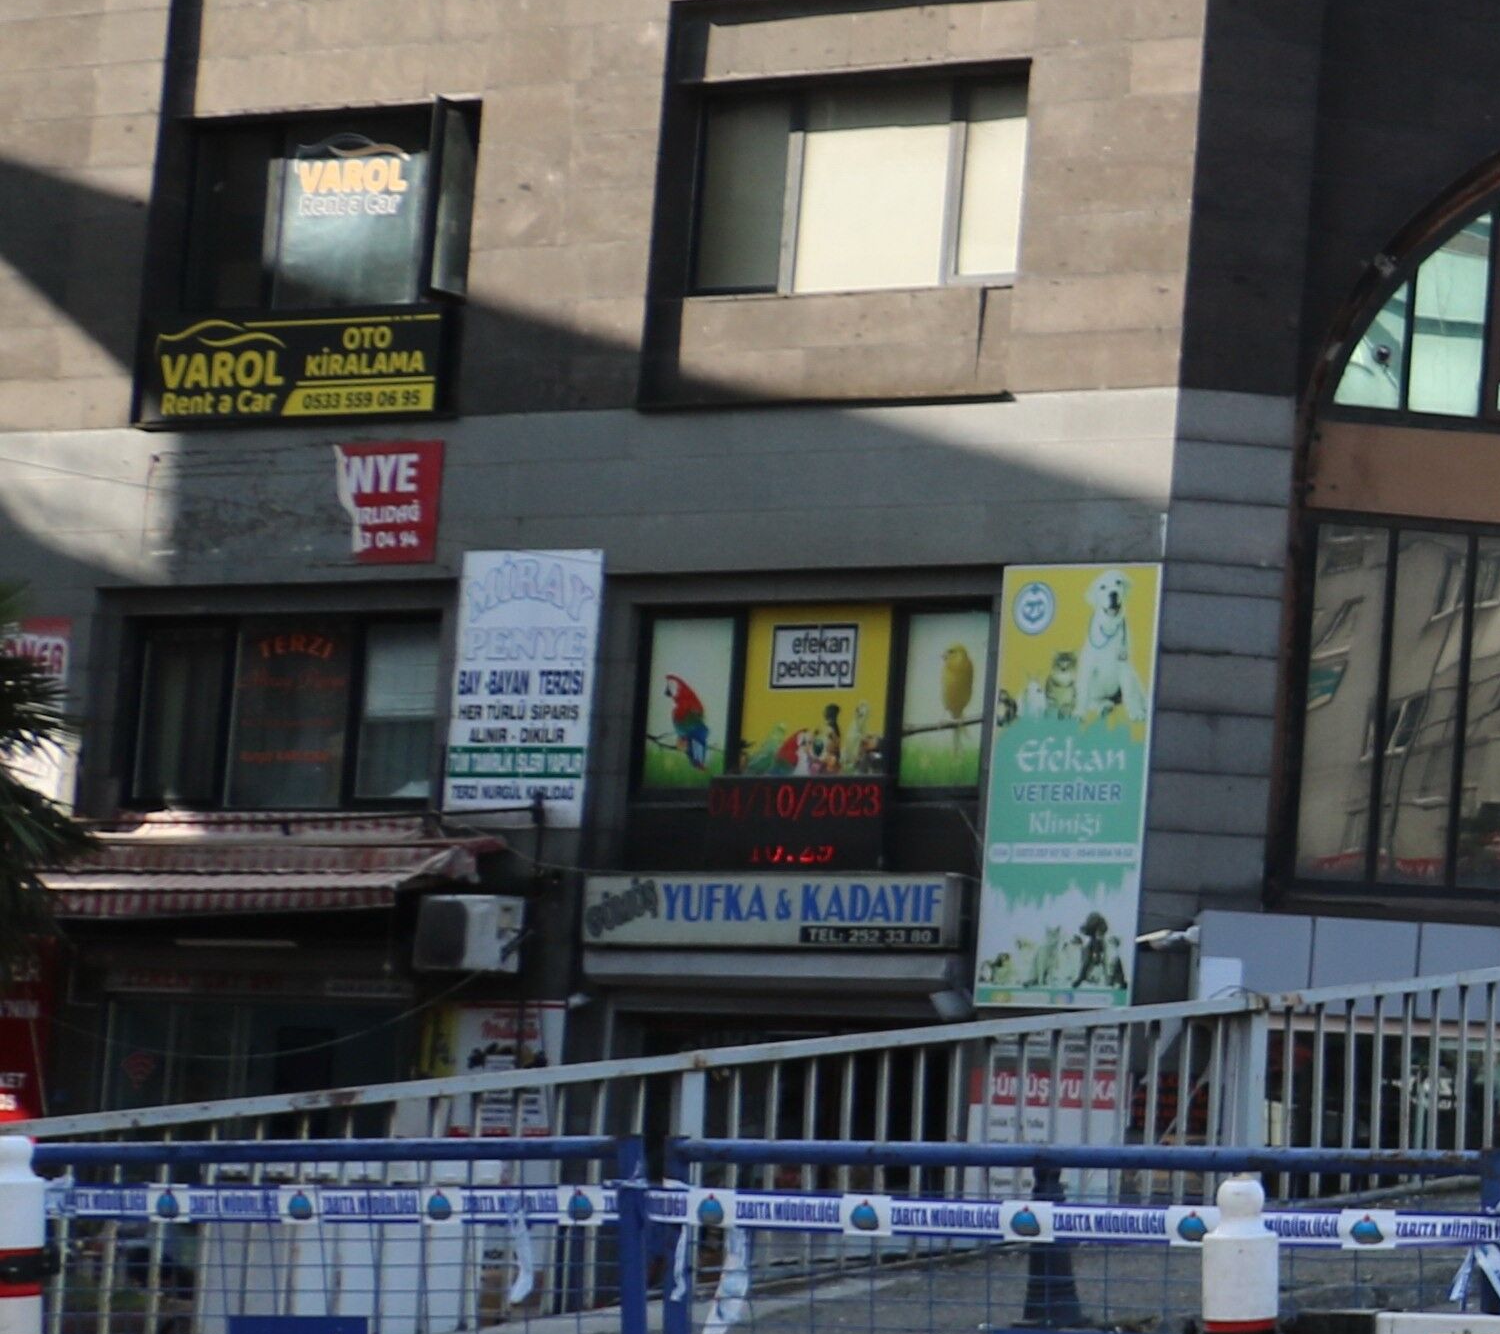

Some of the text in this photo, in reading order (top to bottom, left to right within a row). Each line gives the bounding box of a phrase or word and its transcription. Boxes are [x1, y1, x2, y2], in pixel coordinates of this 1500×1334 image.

[342, 326, 393, 350] OTO
[161, 350, 285, 389] VAROL
[304, 348, 425, 377] KİRALAMA
[161, 390, 277, 415] Rent a Car
[465, 626, 586, 660] PENYE
[792, 628, 850, 655] efekan
[458, 670, 481, 695] BAY
[776, 657, 850, 685] petshop
[458, 699, 579, 725] HER TÜRLÜ SİPARİŞ
[1016, 737, 1127, 773] Efekan
[1013, 778, 1121, 802] VETERİNER
[662, 884, 766, 921] YUFKA
[775, 889, 792, 920] &
[801, 884, 942, 923] KADAYIF
[809, 927, 844, 943] TEL:
[849, 928, 877, 943] 252
[884, 928, 904, 943] 33
[736, 1198, 841, 1223] ZABITA MÜDÜRLÜĞÜ
[891, 1207, 1001, 1229] ZABITA MÜDÜRLÜĞÜ
[1053, 1211, 1166, 1235] ZABITA MÜDÜRLÜĞÜ
[1396, 1221, 1436, 1239] ZABITA
